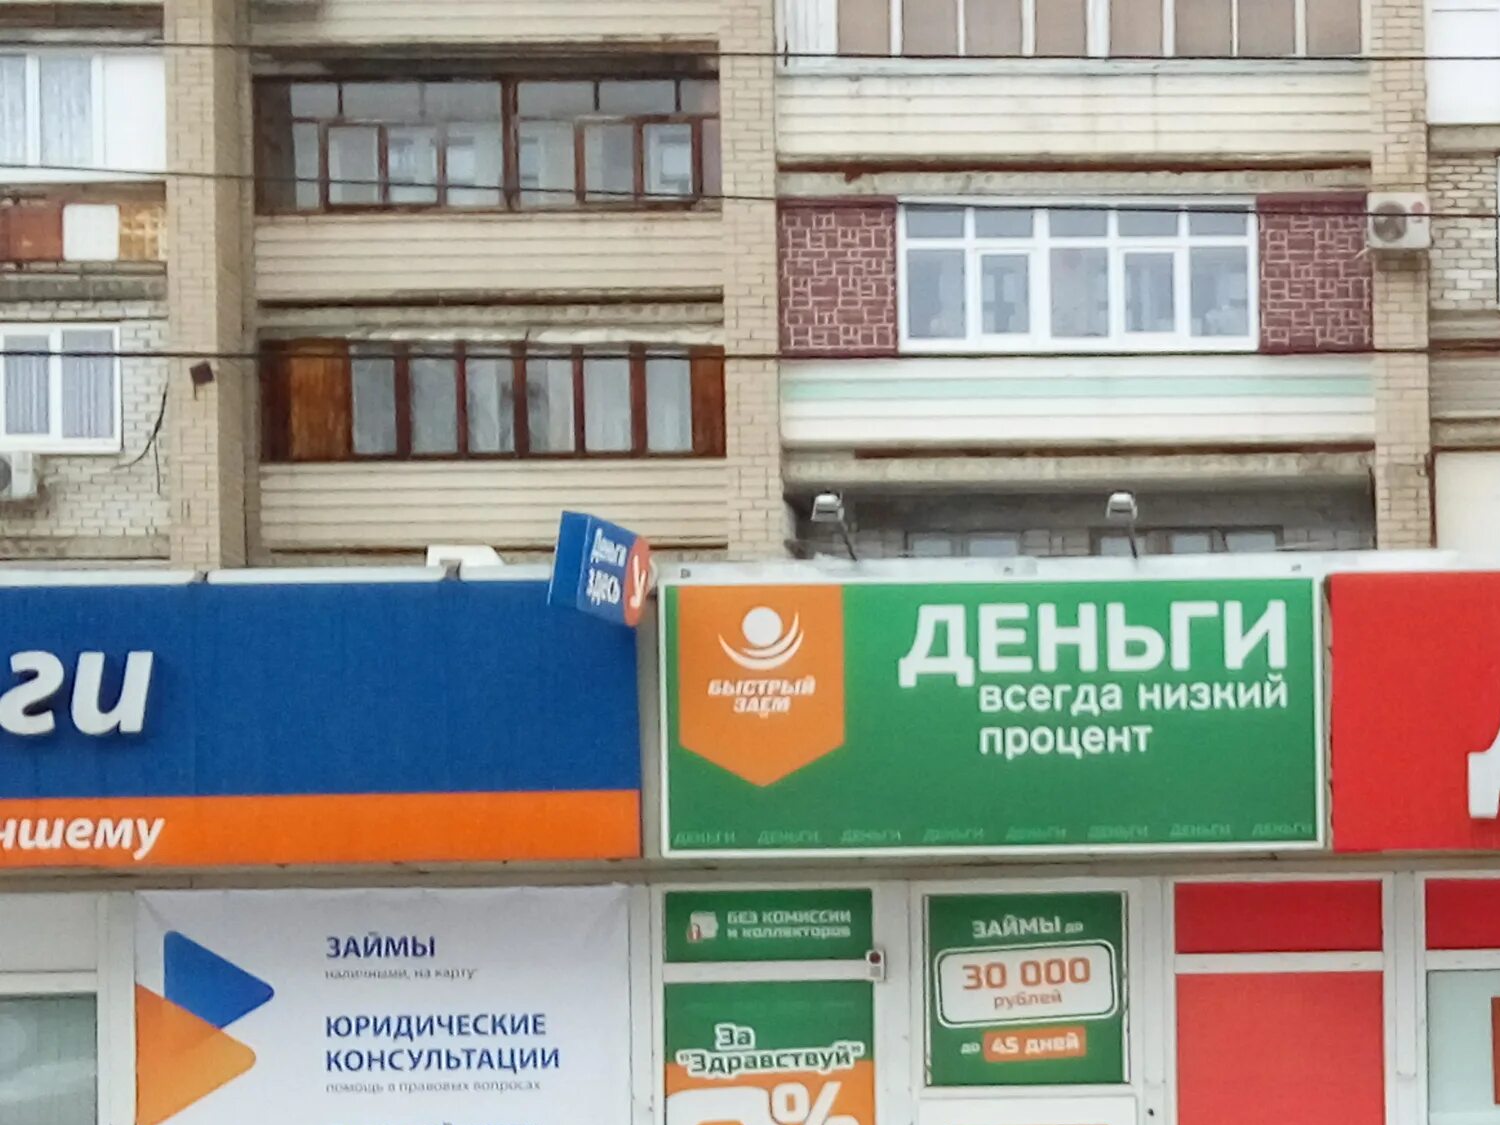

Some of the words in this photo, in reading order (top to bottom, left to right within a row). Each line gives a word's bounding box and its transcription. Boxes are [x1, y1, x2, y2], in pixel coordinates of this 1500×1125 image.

[899, 601, 1287, 686] ДЕНЬГИ
[708, 675, 816, 696] БЫСТРЫЙ
[980, 680, 1122, 715] всегда
[1139, 673, 1288, 709] низкий
[980, 724, 1152, 760] процент
[727, 911, 757, 924] БЕЗ
[762, 910, 851, 923] КОМИССИИ
[972, 914, 1060, 938] ЗАЙМЫ
[326, 931, 436, 958] ЗАЙМЫ
[962, 962, 1007, 990] 30
[1020, 957, 1091, 986] 000
[994, 989, 1063, 1009] рублей
[326, 1013, 546, 1042] ЮРИДИЧЕСКИЕ
[718, 1028, 752, 1046] За
[991, 1037, 1019, 1054] 45
[326, 1048, 559, 1074] КОНСУЛЬТАЦИИ
